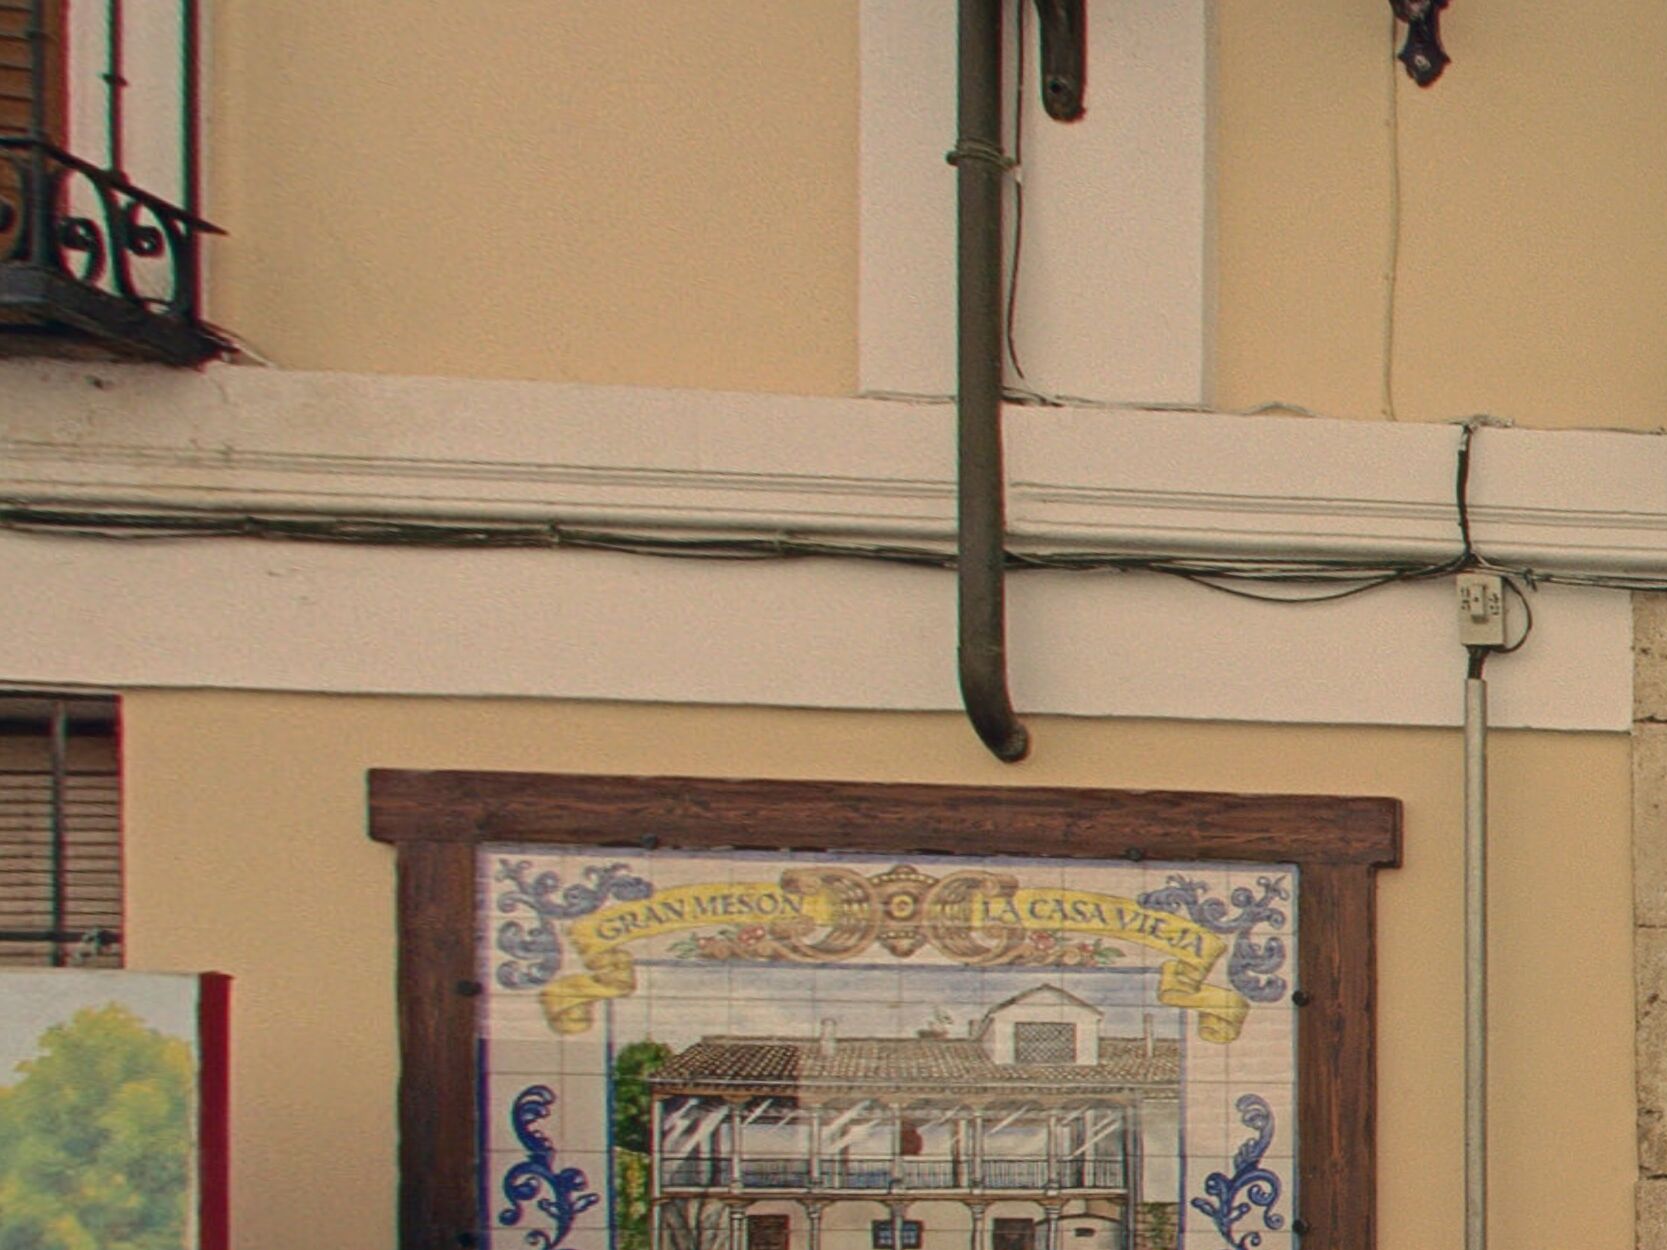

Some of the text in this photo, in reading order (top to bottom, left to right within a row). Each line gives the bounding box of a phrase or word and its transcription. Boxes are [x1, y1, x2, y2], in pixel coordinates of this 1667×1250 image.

[594, 897, 686, 941] GRAN
[981, 897, 1204, 958] LA CASA VIEJA
